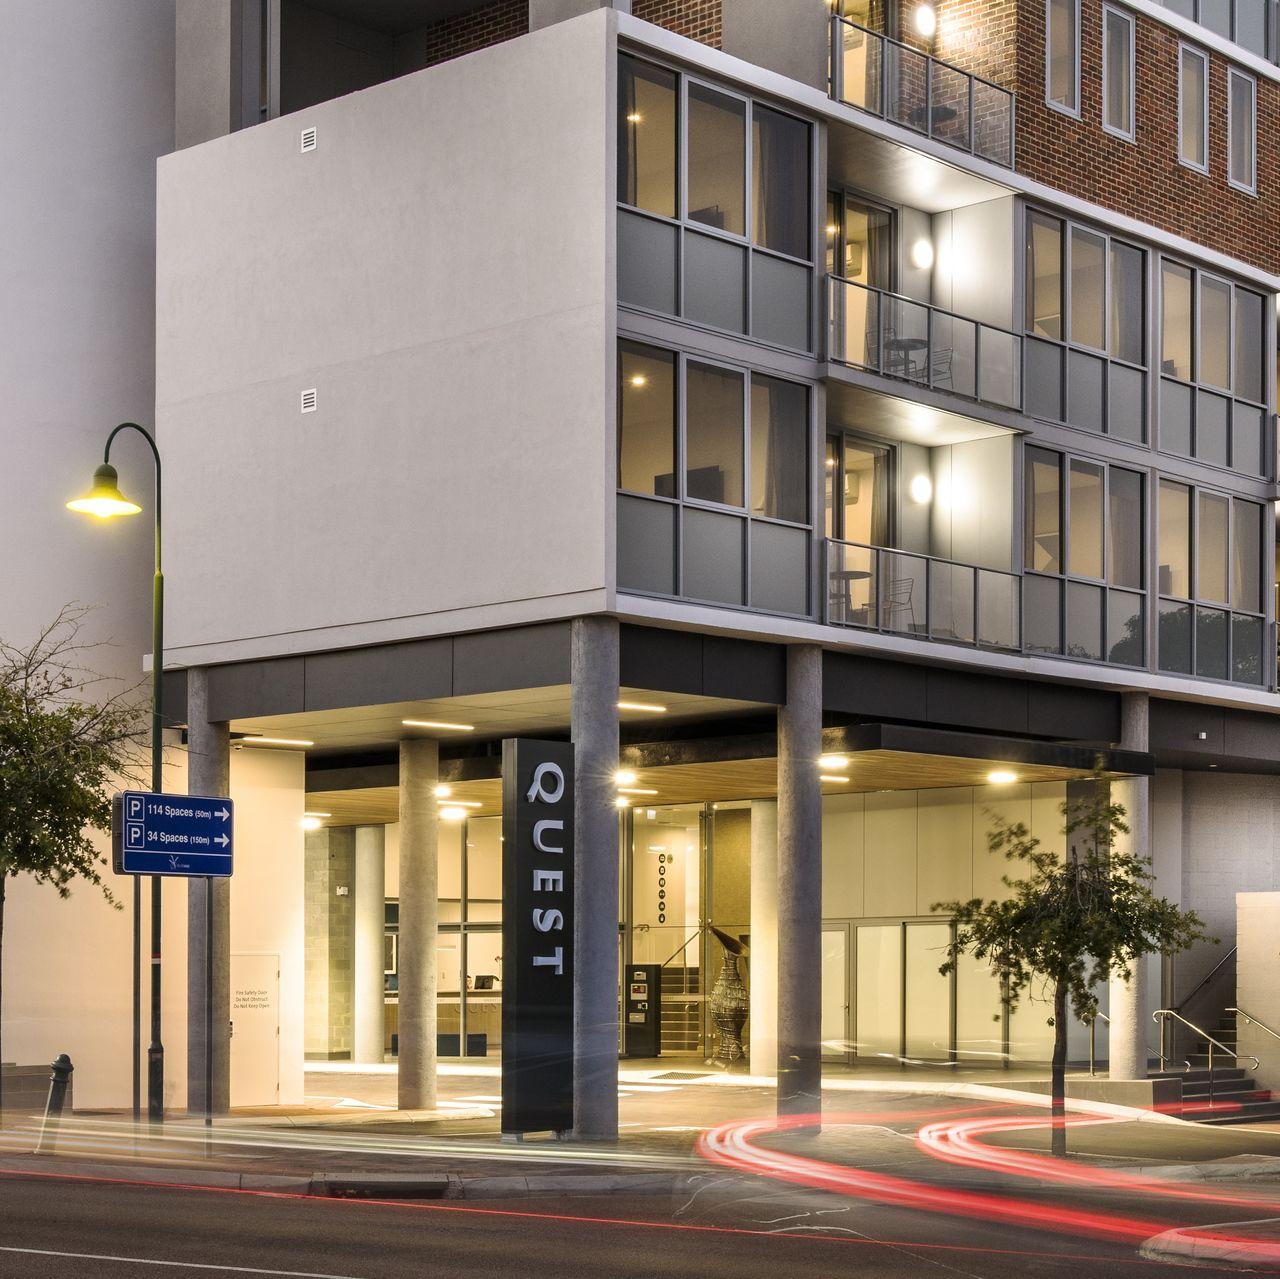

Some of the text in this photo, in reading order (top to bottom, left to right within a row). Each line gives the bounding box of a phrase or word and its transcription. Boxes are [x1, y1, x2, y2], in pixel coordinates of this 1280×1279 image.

[131, 801, 211, 819] P 114 Spaces (50m)
[131, 828, 210, 845] P 34 Spaces (150m)
[527, 762, 565, 976] QUEST
